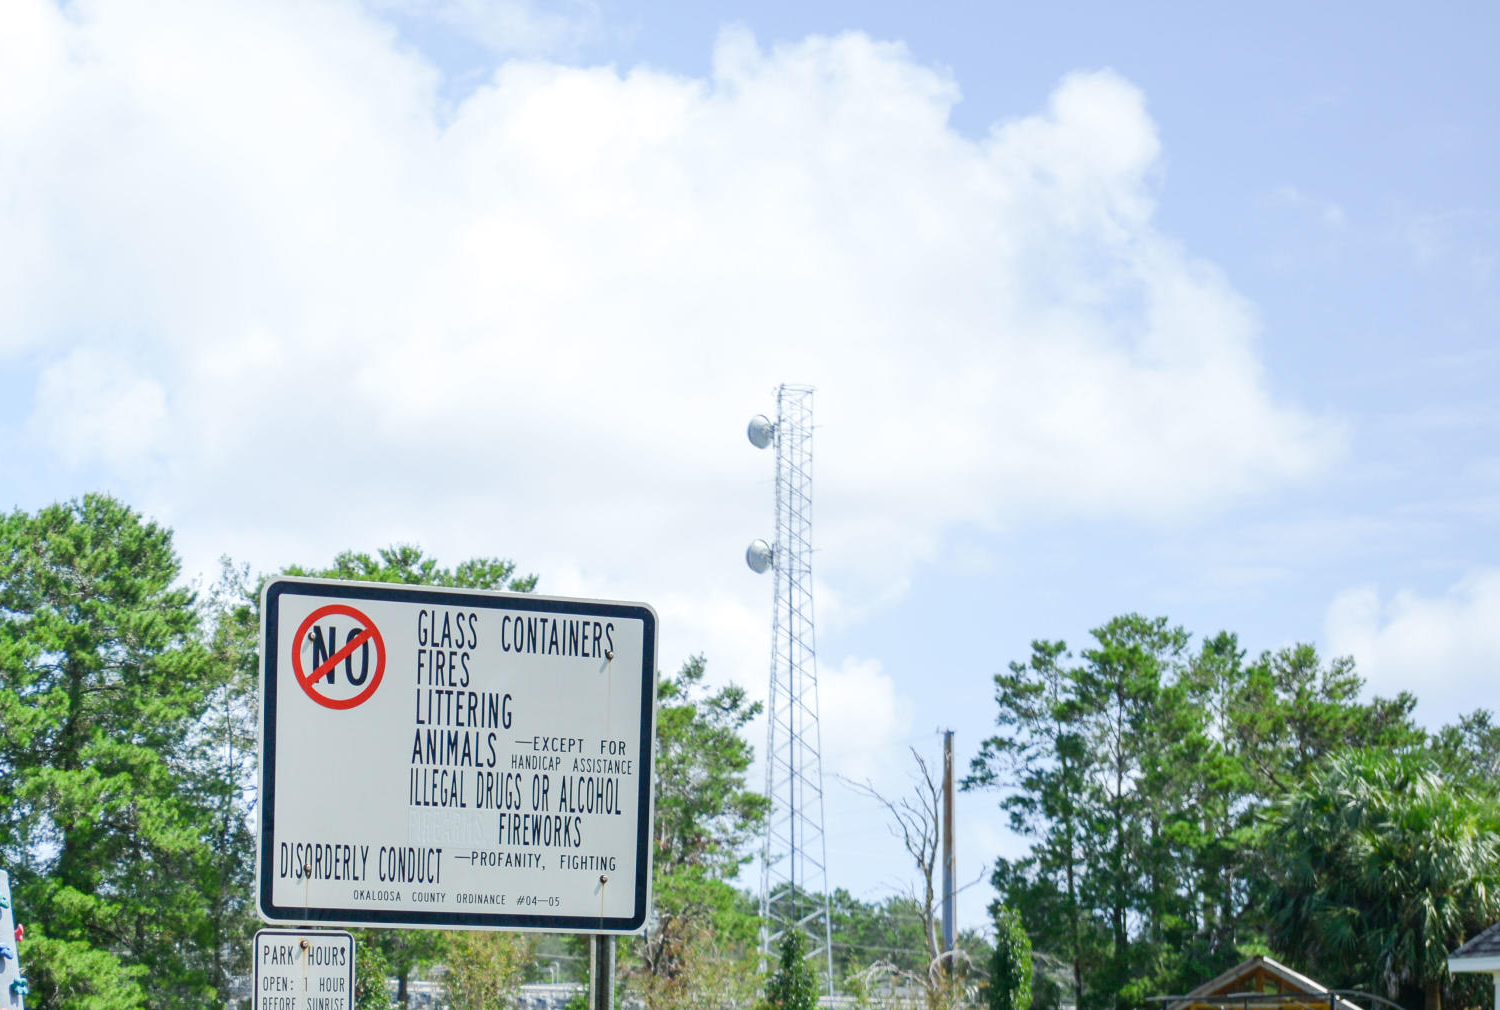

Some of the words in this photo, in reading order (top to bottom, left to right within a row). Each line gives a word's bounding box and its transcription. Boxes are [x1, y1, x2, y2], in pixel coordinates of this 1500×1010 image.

[417, 609, 478, 650] GLASS
[502, 615, 615, 659] CONTAINERS
[312, 625, 370, 686] NO
[416, 649, 471, 687] FIRES
[416, 688, 513, 729] LITTERING
[412, 728, 497, 768] ANIMALS
[600, 740, 627, 756] FOR
[511, 754, 562, 772] HANDICAP
[572, 758, 633, 776] ASSISTANCE
[409, 768, 467, 808] ILLEGAL
[476, 771, 522, 810] DRUGS
[531, 774, 550, 811] OR
[559, 776, 622, 815] ALCOHOL
[499, 813, 582, 848] FIREWORKS
[281, 842, 370, 881] DISORDERLY
[379, 846, 443, 884] CONDUCT
[559, 855, 616, 872] FIGHTING
[353, 890, 402, 902] OKALOOSA
[411, 892, 446, 903] COUNTY
[456, 894, 506, 905] ORDINANCE
[263, 945, 294, 965] PARK
[307, 946, 346, 966] HOURS
[262, 977, 294, 992] OPEN:
[304, 977, 308, 993] 1
[319, 978, 345, 993] HOUR
